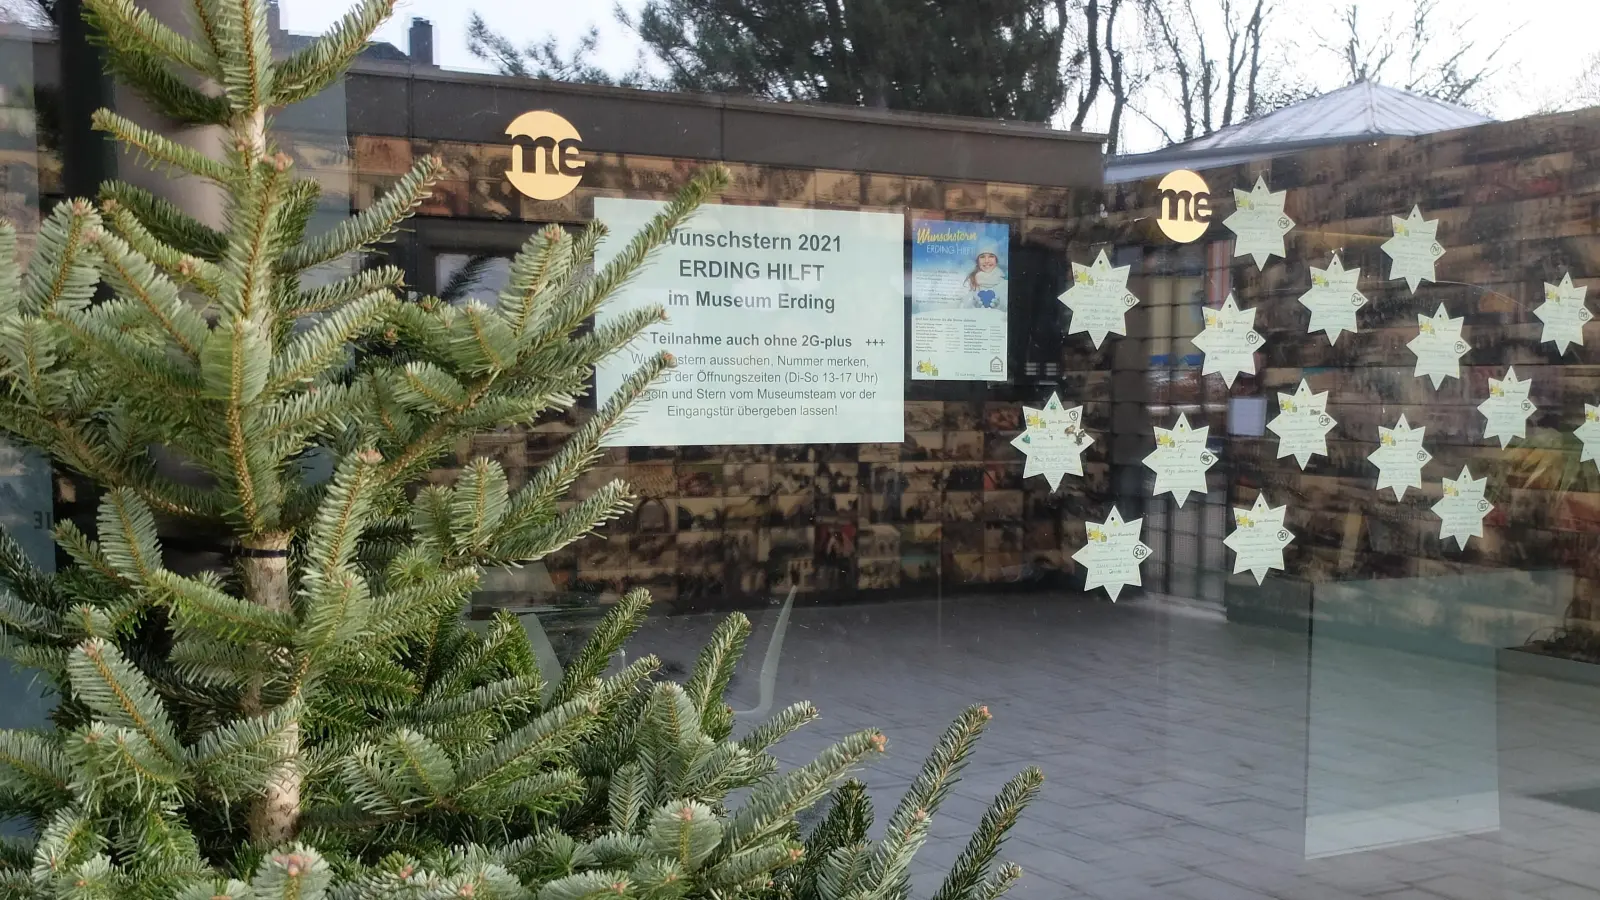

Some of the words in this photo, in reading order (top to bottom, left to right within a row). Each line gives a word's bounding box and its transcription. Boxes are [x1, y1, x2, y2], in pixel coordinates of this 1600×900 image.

[663, 227, 792, 251] Wunschstern
[798, 233, 842, 252] 2021
[926, 244, 955, 255] ERDING
[679, 260, 761, 280] ERDING
[767, 263, 825, 282] HILFT
[668, 289, 690, 306] im
[695, 291, 772, 309] Museum
[778, 293, 836, 313] Erding
[650, 332, 722, 346] Teilnahme
[726, 333, 760, 347] auch
[763, 334, 798, 347] ohne
[801, 335, 853, 350] 2G-plus
[709, 355, 774, 369] aussuchen,
[777, 355, 824, 368] Nummer
[827, 356, 870, 369] merken,
[675, 371, 693, 382] der
[696, 370, 782, 386] Öffnungszeiten
[784, 372, 819, 385] (Di-So
[823, 373, 852, 384] 13-17
[855, 373, 879, 386] Uhr)
[672, 388, 693, 400] und
[696, 388, 726, 400] Stern
[729, 391, 754, 400] vom
[757, 389, 837, 400] Museumsteam
[840, 391, 857, 400] vor
[859, 389, 876, 400] der
[667, 405, 734, 419] Eingangstür
[737, 404, 797, 419] übergeben
[800, 405, 838, 416] lassen!
